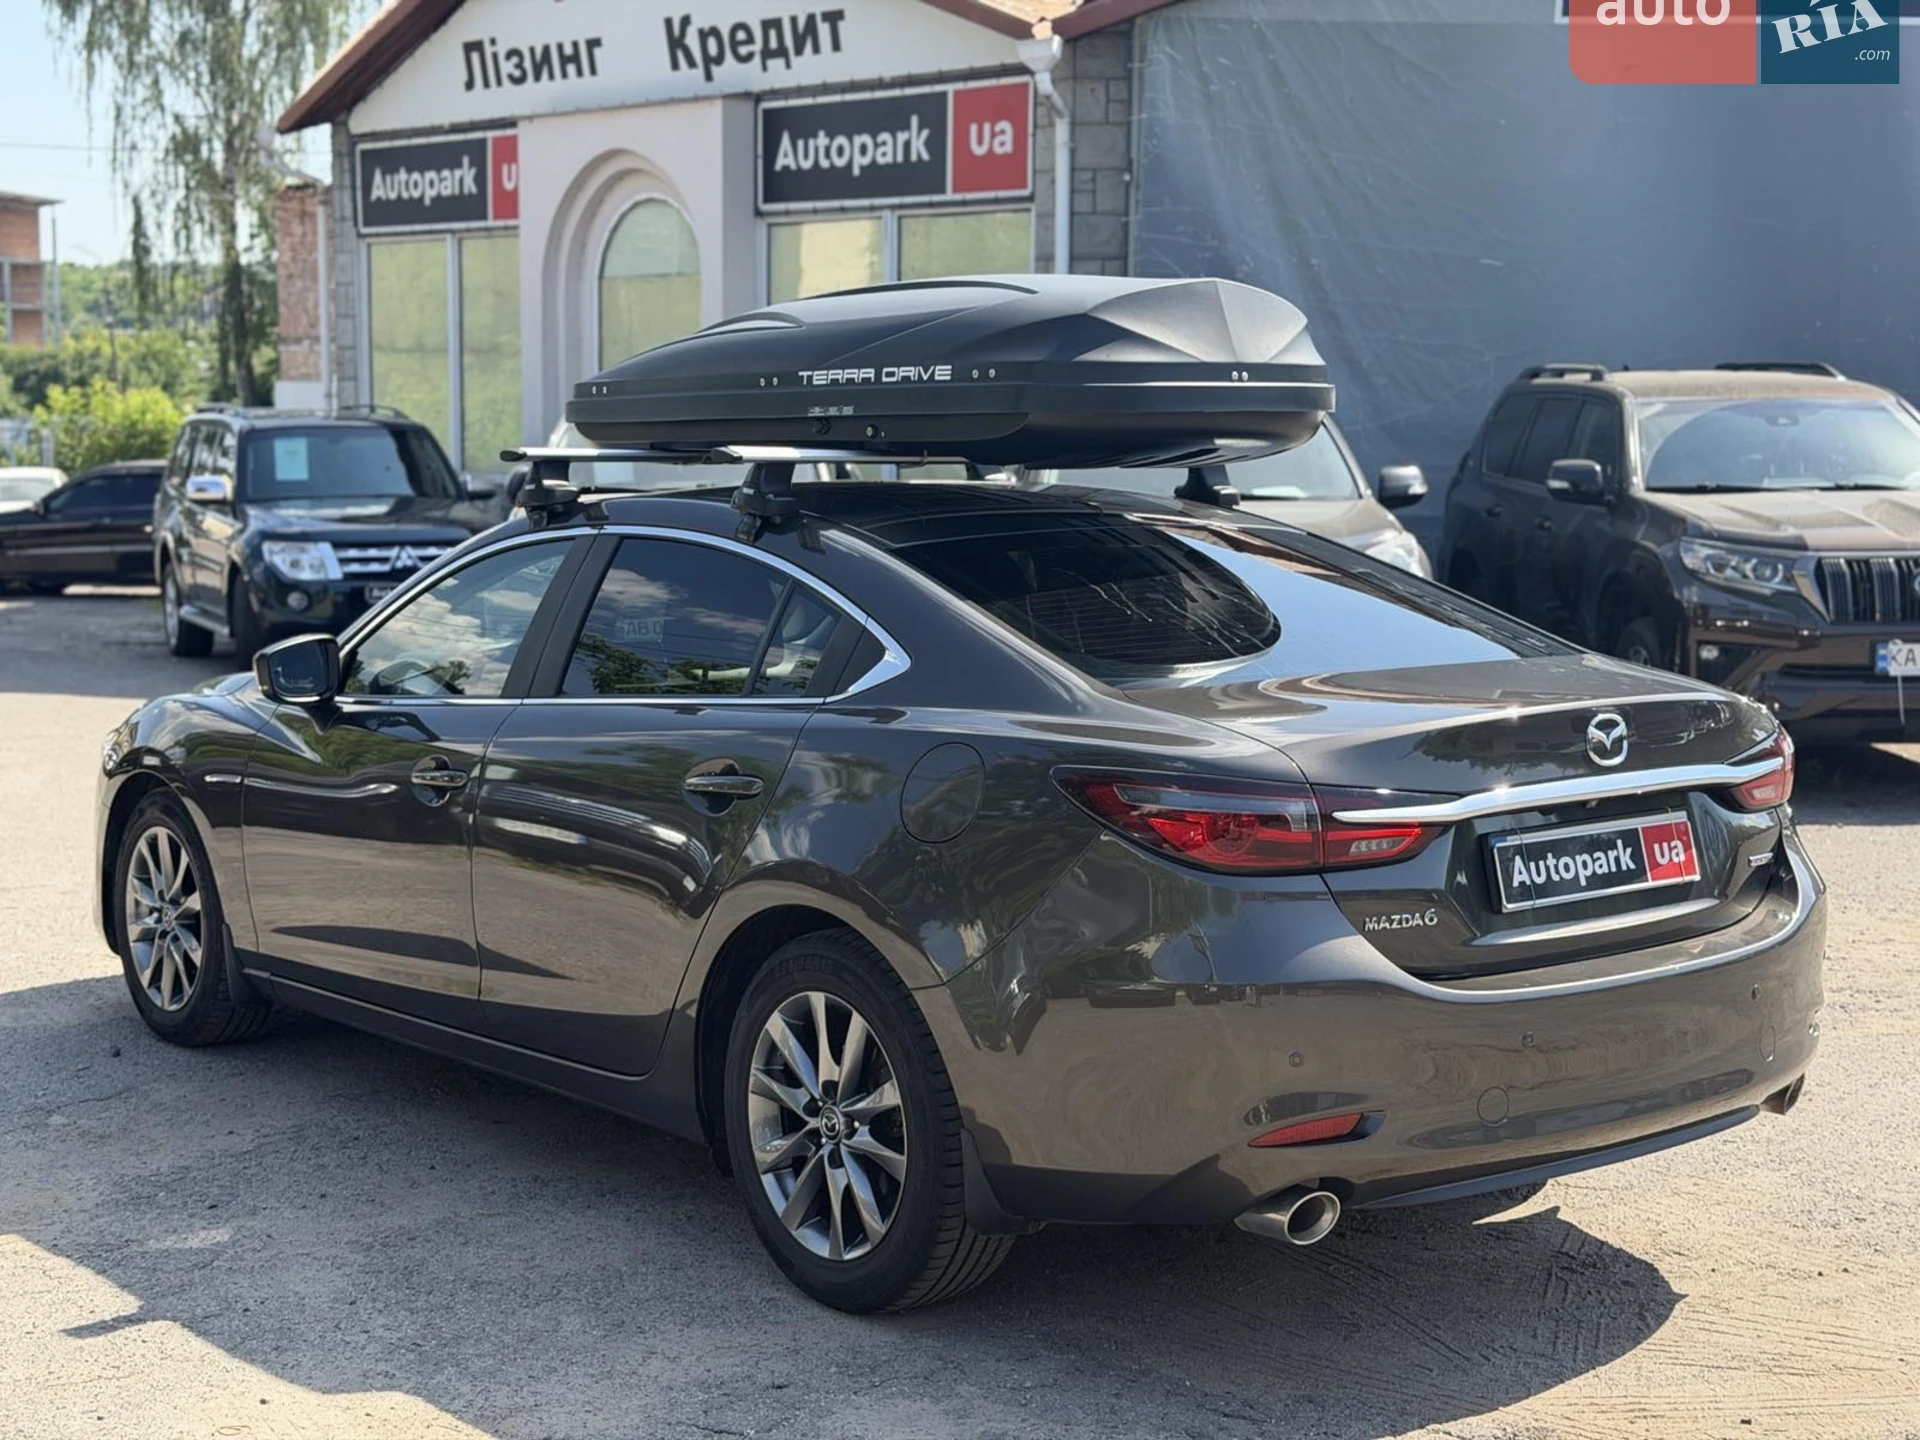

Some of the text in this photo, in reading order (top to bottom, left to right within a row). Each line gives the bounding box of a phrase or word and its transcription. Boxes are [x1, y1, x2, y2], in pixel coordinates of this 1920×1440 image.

[462, 8, 846, 92] Лізинг Кредит
[773, 114, 1014, 177] Autopark ua
[370, 154, 517, 207] Autopark u
[798, 365, 953, 385] TERRA DRIVE
[1889, 647, 1918, 668] KA
[1512, 838, 1687, 887] Autopark ua
[1364, 907, 1439, 932] MAZDA6
